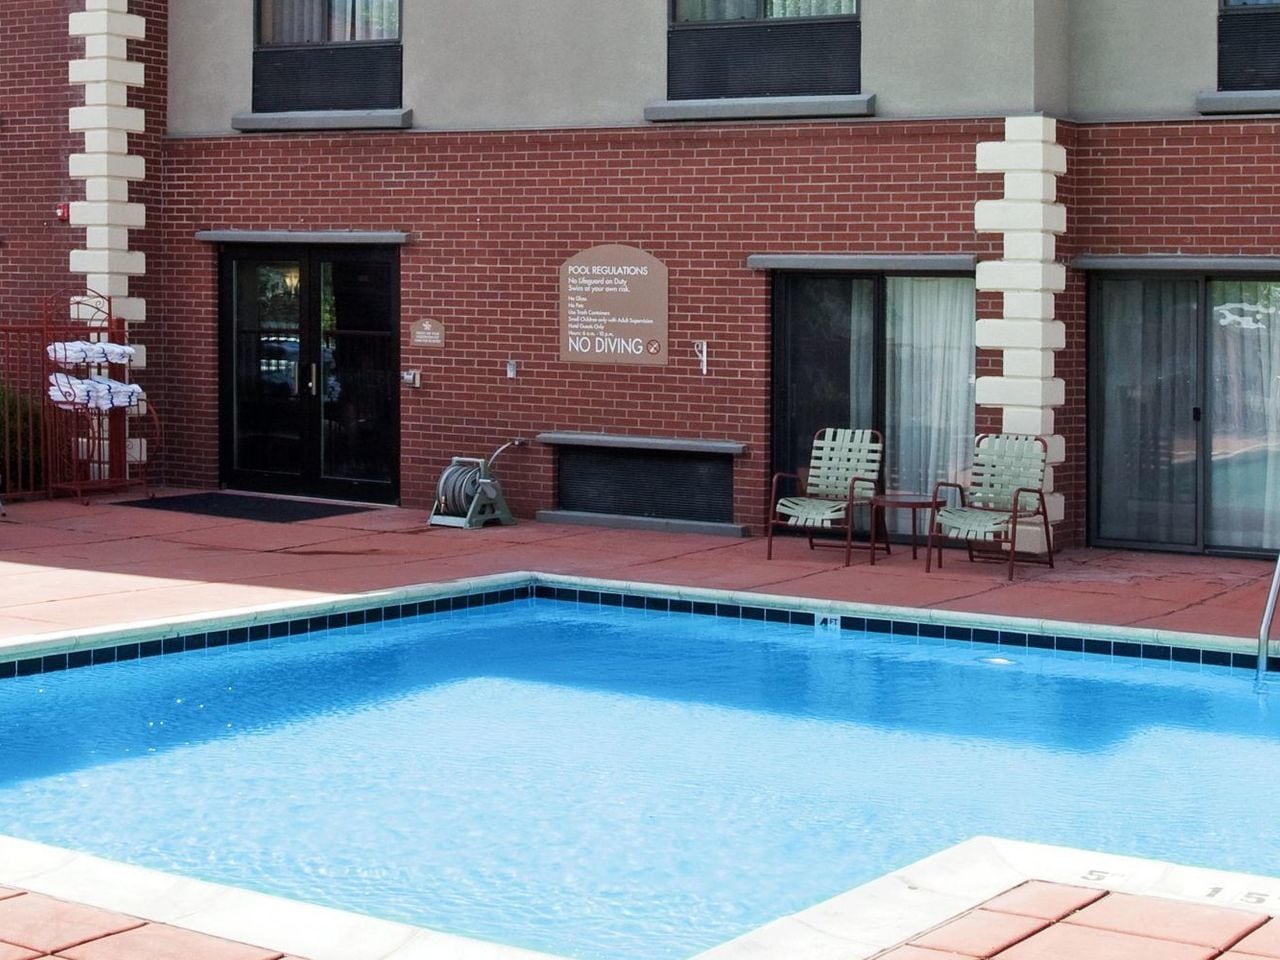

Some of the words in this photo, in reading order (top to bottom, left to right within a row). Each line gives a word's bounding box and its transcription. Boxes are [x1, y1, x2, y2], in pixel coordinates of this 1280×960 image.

[568, 266, 590, 274] POOL
[592, 266, 648, 275] REGULATIONS
[578, 277, 605, 285] Lifeguard
[613, 278, 627, 286] Duty
[568, 337, 591, 352] NO
[595, 338, 643, 354] DIVING
[1080, 870, 1110, 881] 5
